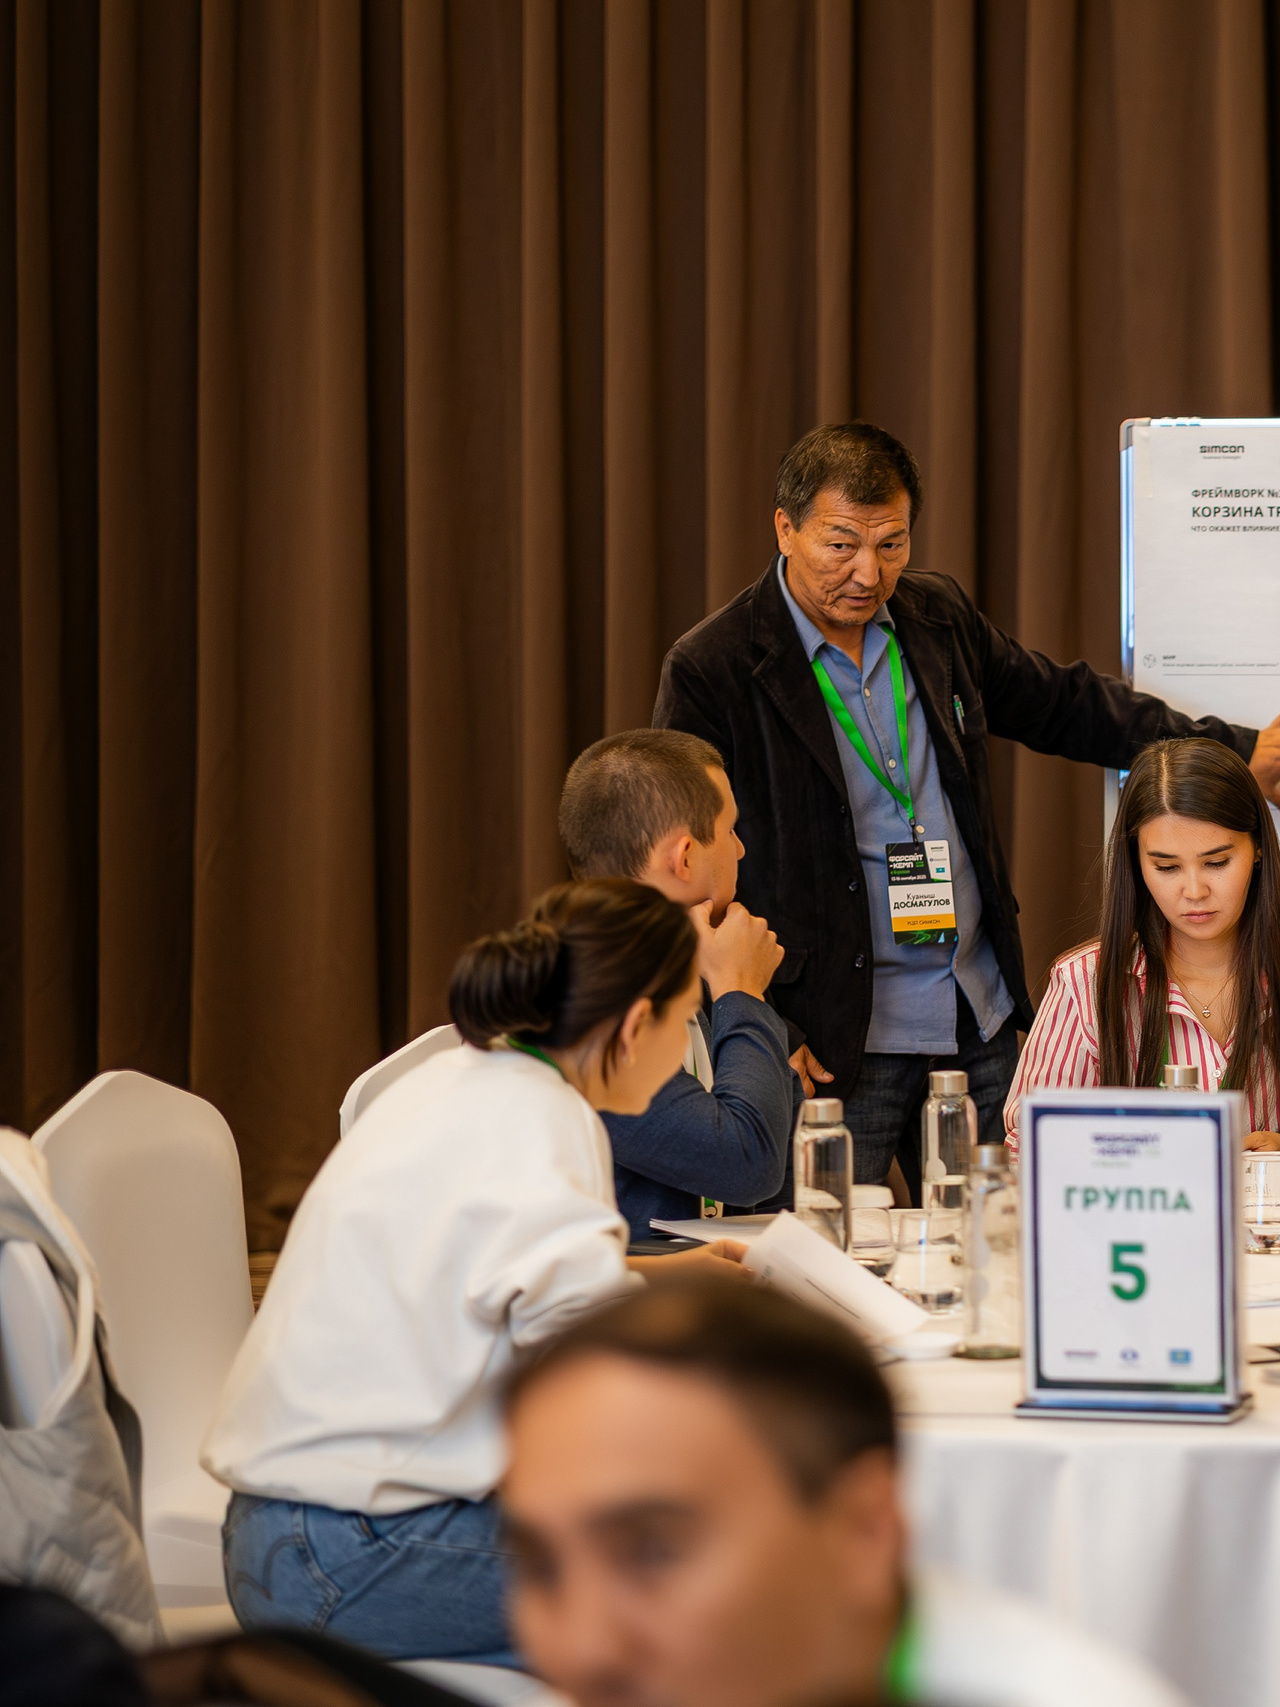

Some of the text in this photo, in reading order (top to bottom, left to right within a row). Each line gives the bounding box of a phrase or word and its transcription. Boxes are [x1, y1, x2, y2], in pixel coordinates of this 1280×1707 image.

[1199, 445, 1245, 454] simcon
[1191, 486, 1265, 498] ФРЕЙМВОРК
[1192, 505, 1264, 518] КОРЗИНА
[888, 853, 924, 862] ФОРСАЙТ
[906, 893, 936, 901] Куаныш
[893, 898, 951, 910] ДОСМАГУЛОВ
[1063, 1185, 1192, 1213] ГРУППА
[1109, 1241, 1148, 1302] 5
